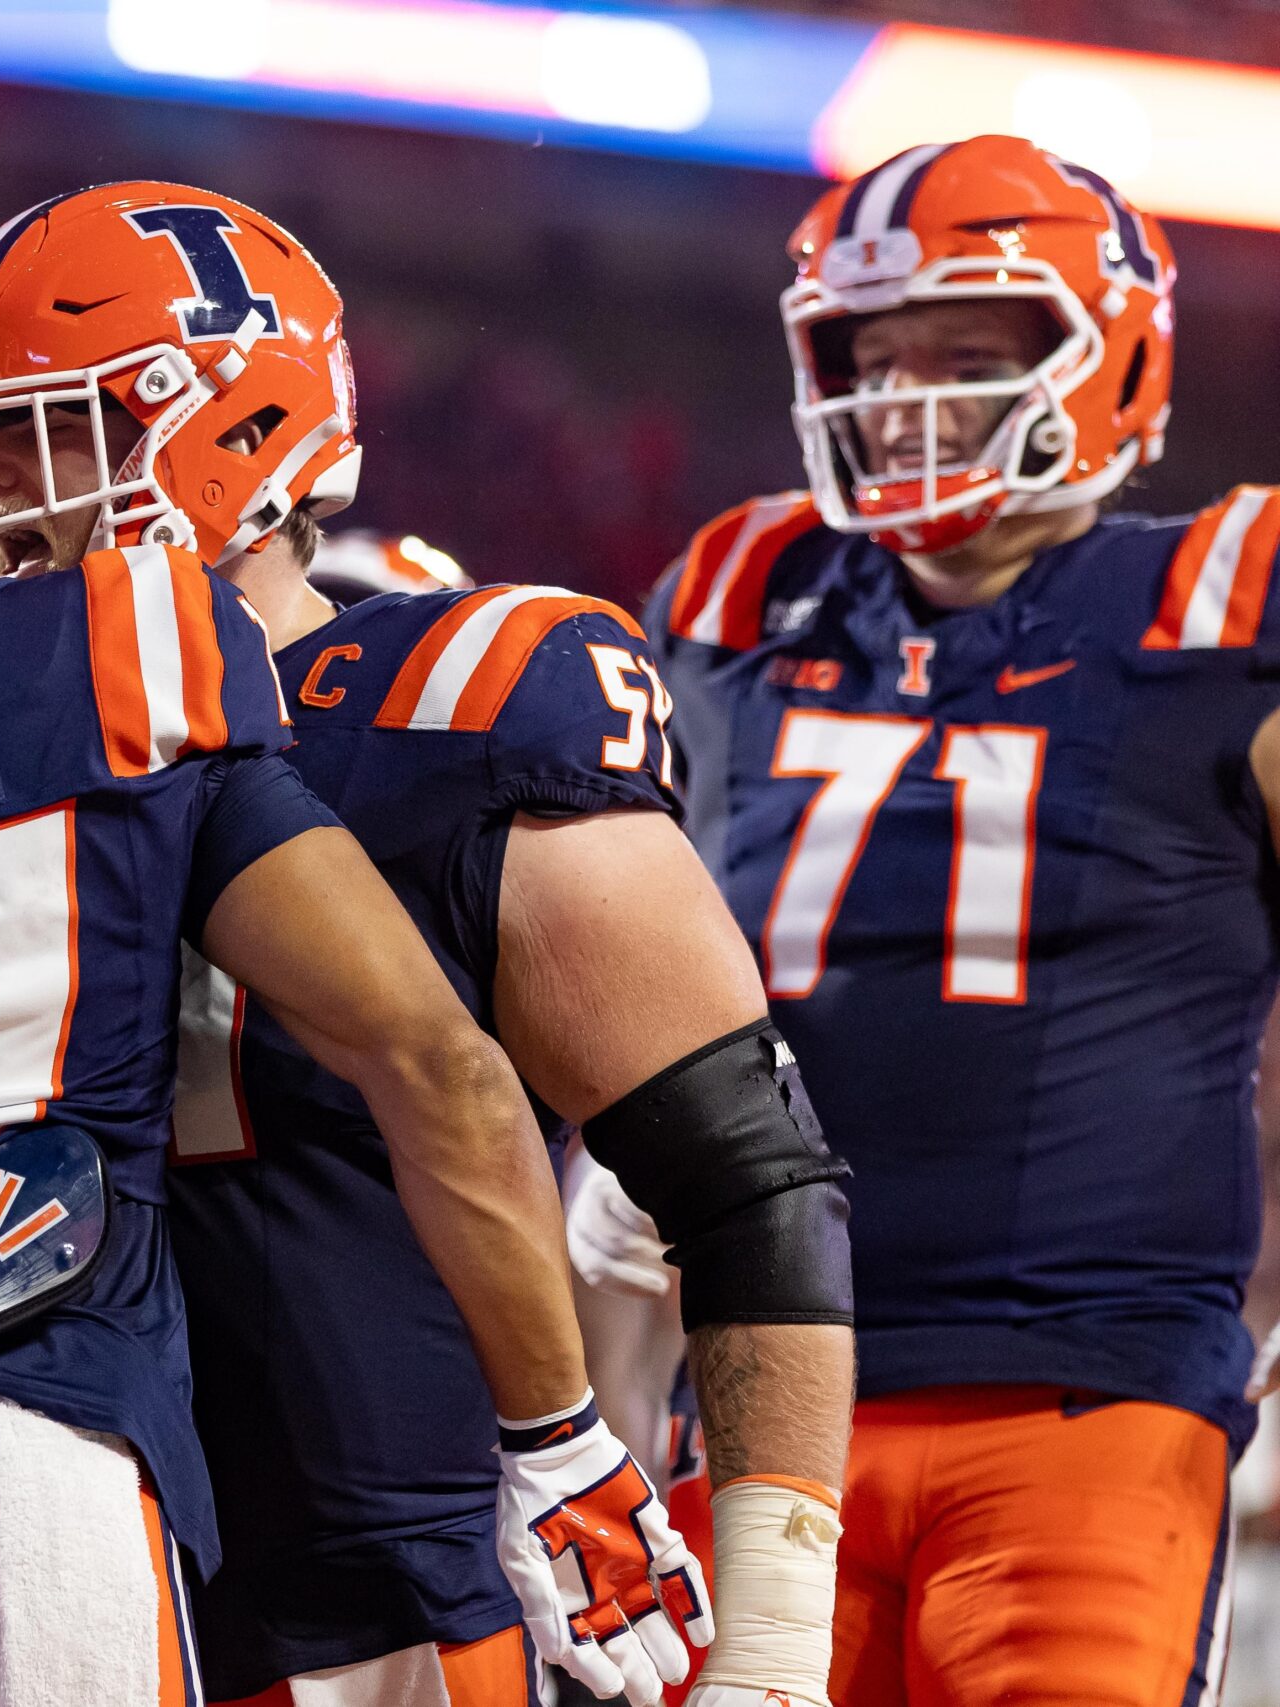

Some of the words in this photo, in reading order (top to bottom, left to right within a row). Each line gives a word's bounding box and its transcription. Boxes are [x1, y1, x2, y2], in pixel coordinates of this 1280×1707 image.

[120, 204, 284, 344] I
[298, 643, 363, 709] C
[897, 636, 937, 697] I
[762, 708, 1048, 1005] 71
